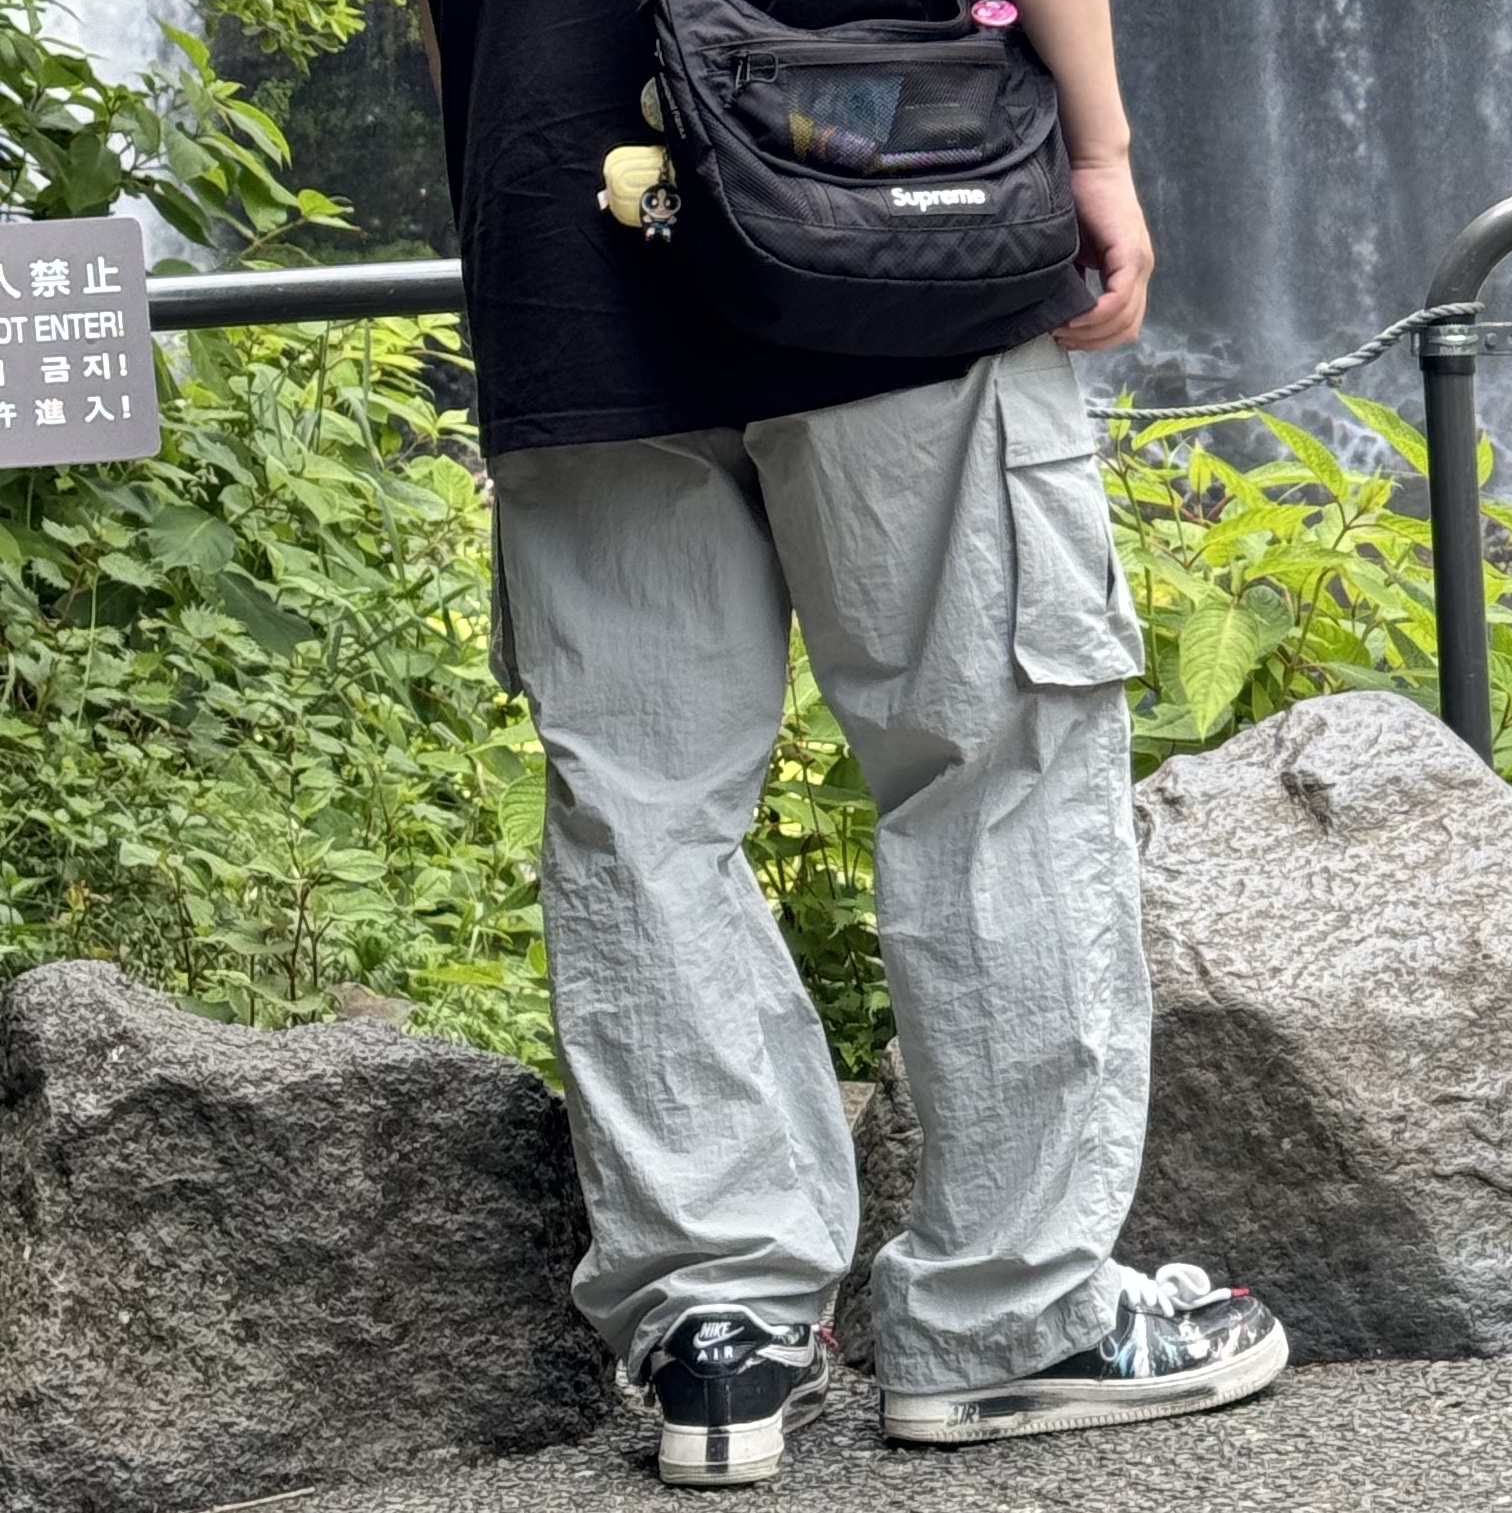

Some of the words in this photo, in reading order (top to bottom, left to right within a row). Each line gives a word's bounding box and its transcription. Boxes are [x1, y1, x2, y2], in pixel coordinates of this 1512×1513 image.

[891, 186, 986, 212] Supreme
[34, 310, 125, 342] ENTER!
[40, 352, 128, 384] 금지!
[699, 1321, 732, 1338] NIKE
[696, 1345, 734, 1364] AIR
